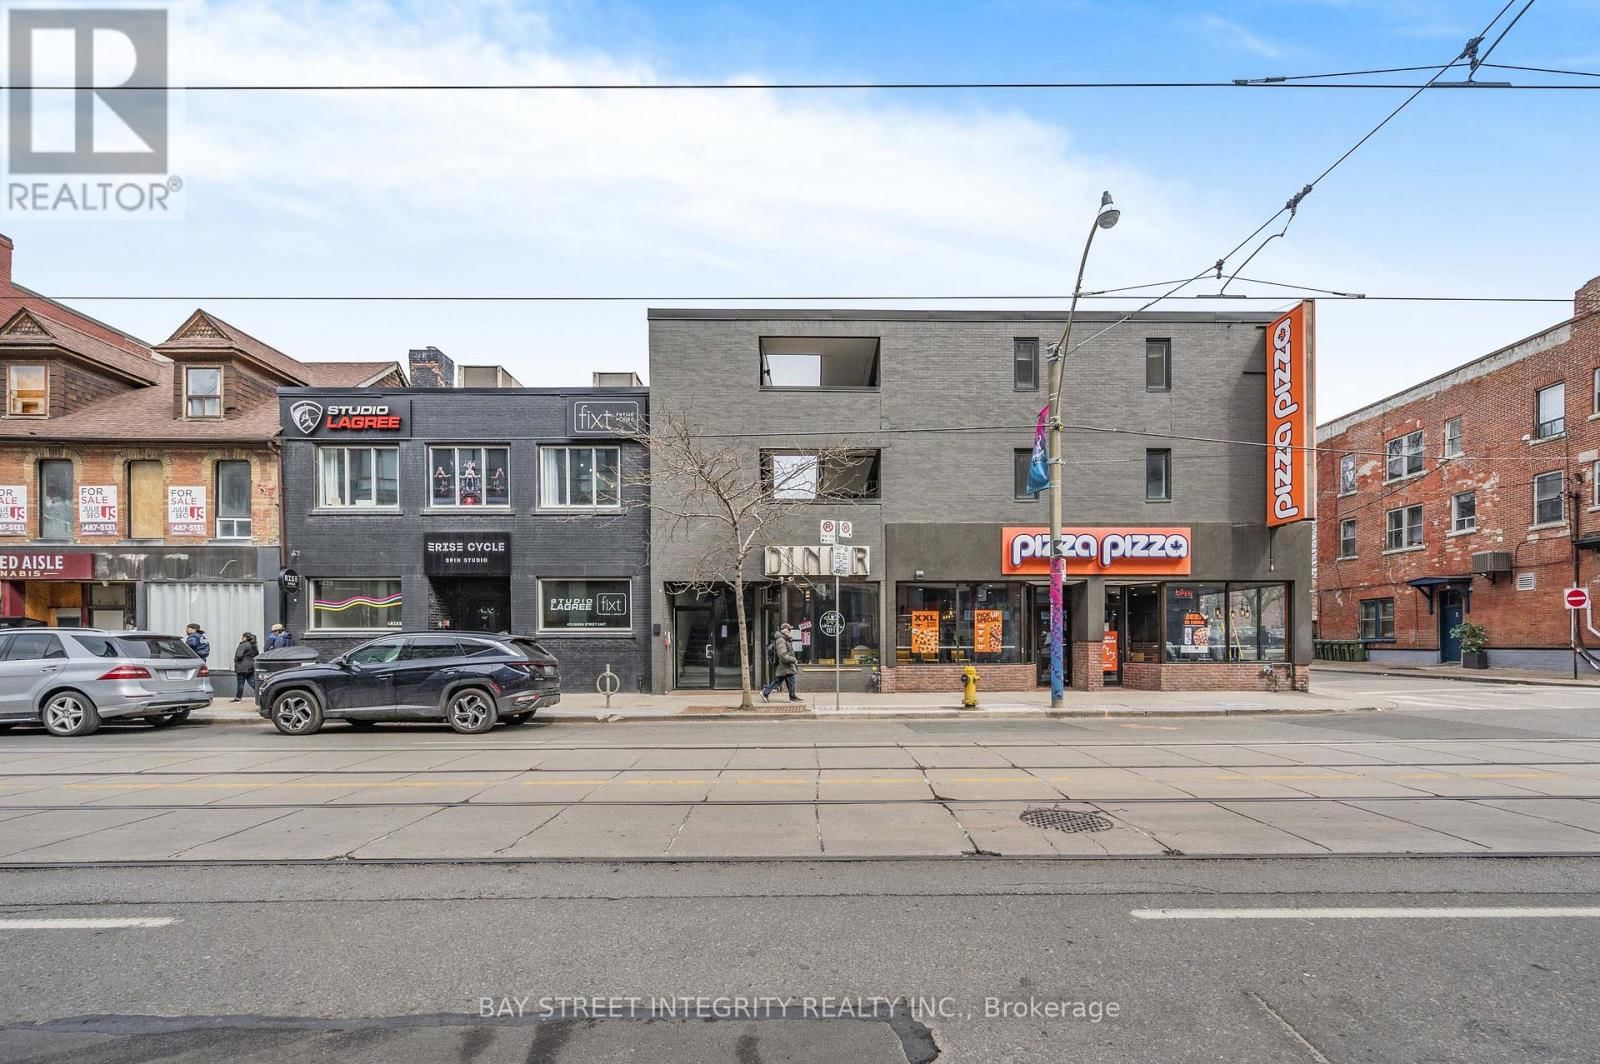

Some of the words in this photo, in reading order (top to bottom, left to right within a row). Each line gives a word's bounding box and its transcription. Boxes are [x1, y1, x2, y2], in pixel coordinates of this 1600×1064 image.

[1273, 317, 1299, 420] pizza
[327, 405, 389, 415] STUDIO
[578, 405, 613, 430] fixt
[326, 416, 401, 430] LAGREE
[1273, 421, 1300, 520] pizza
[0, 489, 13, 497] OR
[81, 488, 104, 496] FOR
[171, 489, 193, 497] FOR
[0, 497, 18, 505] ALE
[81, 496, 109, 504] SALE
[171, 497, 198, 505] SALE
[467, 542, 505, 552] CYCLE
[1101, 533, 1188, 567] pizza
[0, 555, 19, 570] ED
[22, 555, 64, 570] AISLE
[766, 547, 869, 575] DINR
[550, 603, 593, 611] LAGREE
[600, 596, 622, 612] fixt
[914, 614, 937, 622] XXL
